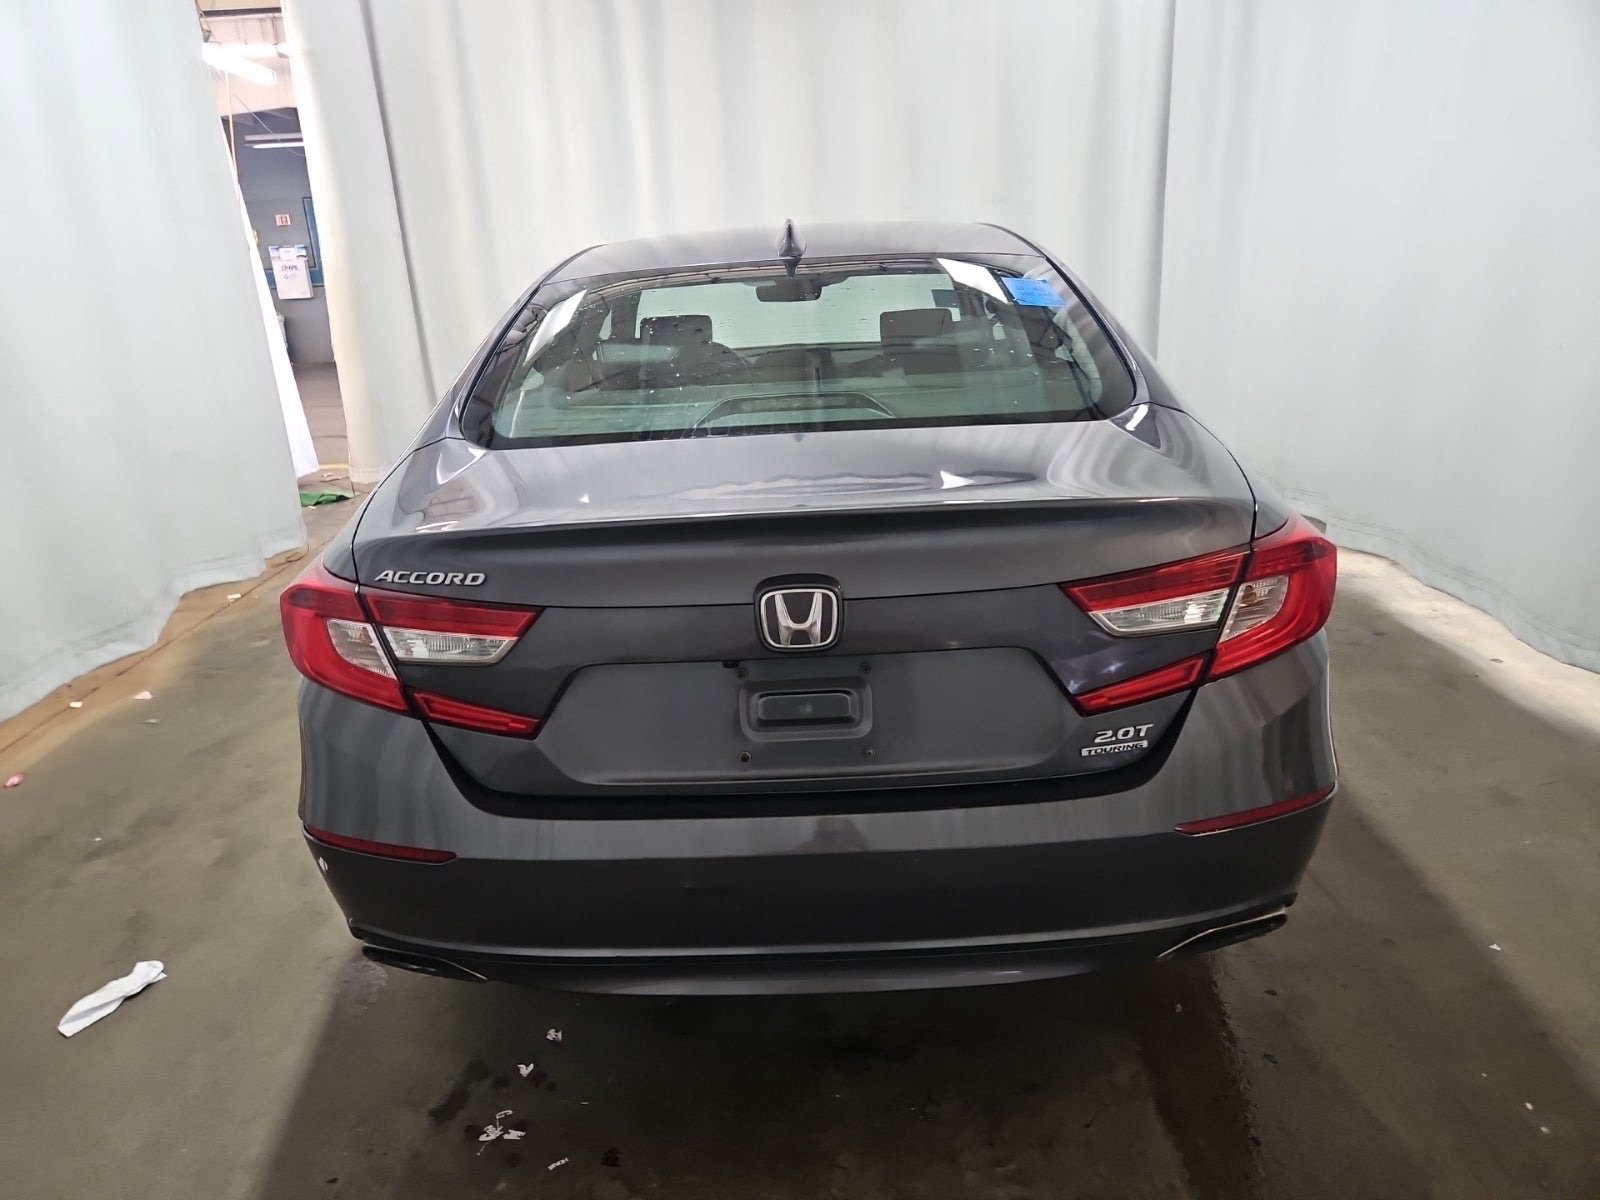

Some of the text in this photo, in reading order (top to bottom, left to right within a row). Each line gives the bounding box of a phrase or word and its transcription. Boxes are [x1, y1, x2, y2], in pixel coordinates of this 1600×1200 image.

[374, 569, 486, 586] ACCORD
[1094, 723, 1154, 743] 2.0T
[1085, 742, 1145, 756] TOURING
